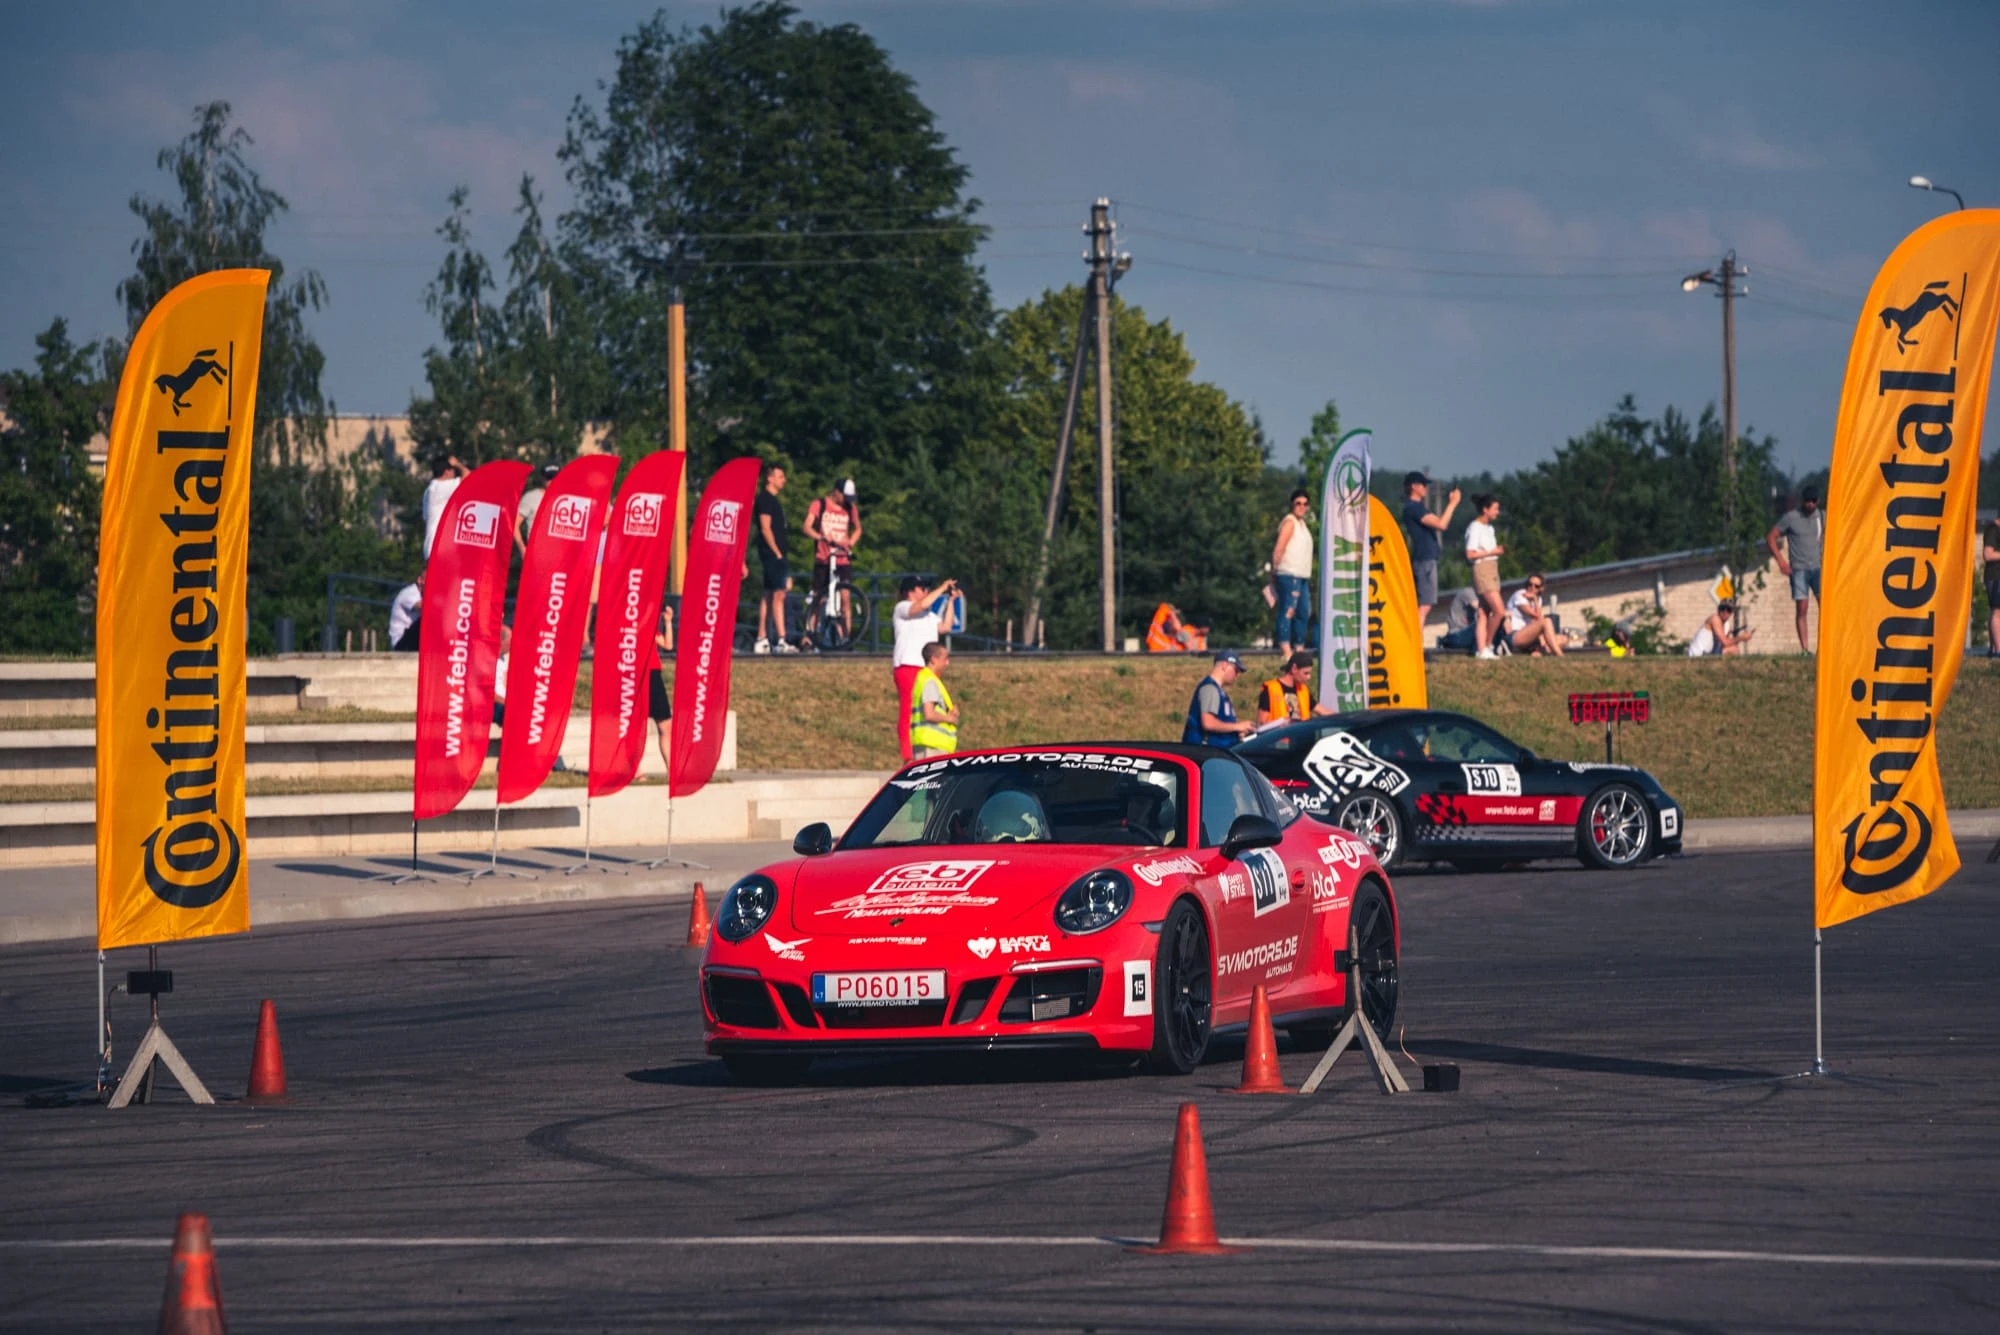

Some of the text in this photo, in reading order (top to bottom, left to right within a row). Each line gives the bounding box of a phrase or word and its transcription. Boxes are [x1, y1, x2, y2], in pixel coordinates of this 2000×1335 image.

[551, 496, 589, 531] febi
[1333, 535, 1362, 638] RALLY
[1842, 366, 1957, 894] Continental
[527, 571, 567, 745] www.febi.com
[617, 568, 643, 738] www.febi.com
[692, 574, 721, 743] www.febi.com
[143, 426, 241, 909] Continental
[445, 578, 475, 757] www.febi.com
[907, 752, 1154, 777] RSVMOTORS.DE
[1060, 762, 1138, 775] AUTOHAUS
[1471, 768, 1498, 788] S10
[1485, 805, 1534, 816] www.febi.com
[1229, 882, 1246, 898] STYLE
[1312, 871, 1337, 900] bta
[1000, 941, 1051, 954] STYLE
[1265, 961, 1293, 979] AUTOHAUS
[814, 975, 930, 1000] LT P06015
[1133, 980, 1145, 996] 15
